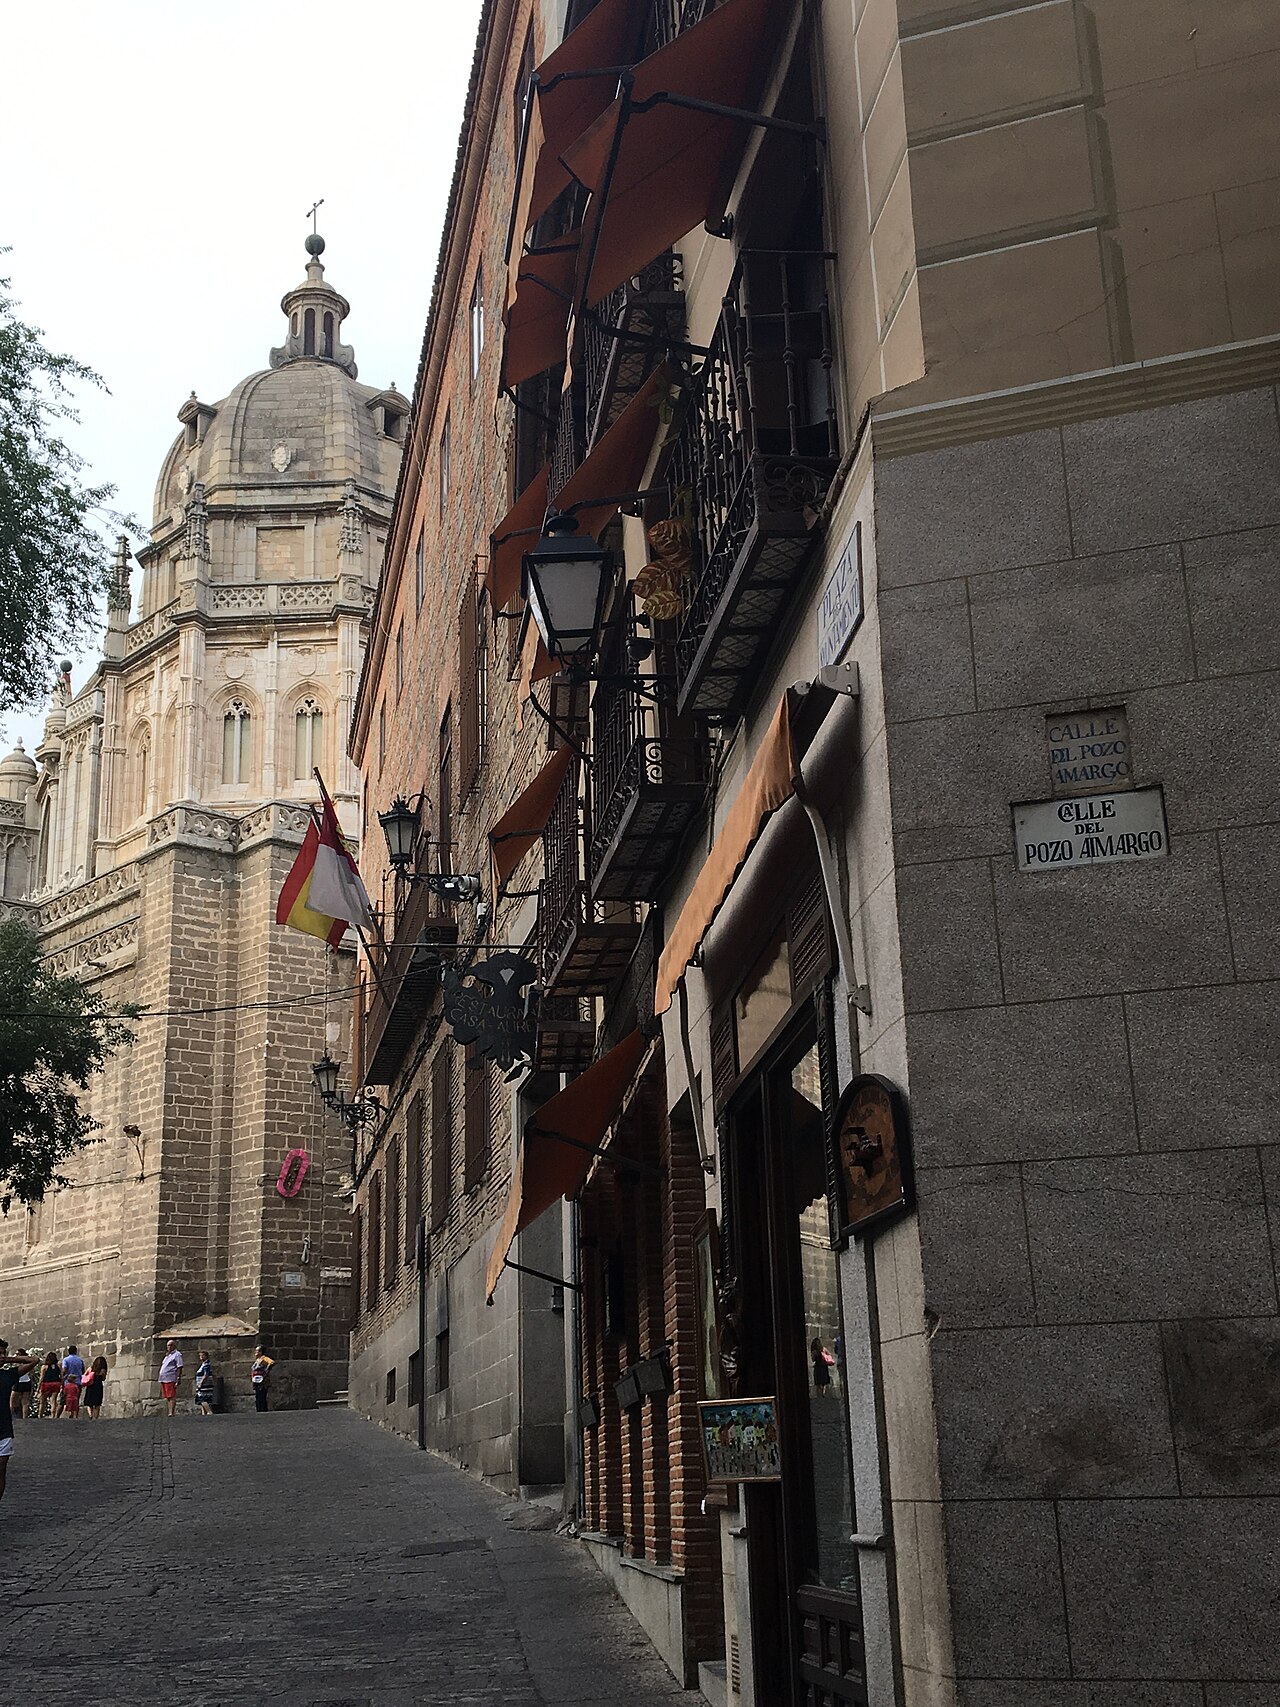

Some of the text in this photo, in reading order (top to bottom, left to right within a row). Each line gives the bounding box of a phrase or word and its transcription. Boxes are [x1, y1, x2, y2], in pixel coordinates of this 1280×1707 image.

[822, 551, 853, 628] PLAZA
[1049, 717, 1119, 743] CALLE
[1079, 740, 1127, 760] POZO
[1055, 761, 1131, 784] AMARGO
[1058, 799, 1116, 823] CALLE
[1074, 821, 1105, 836] DEL
[1024, 830, 1163, 865] POZO AMARGO
